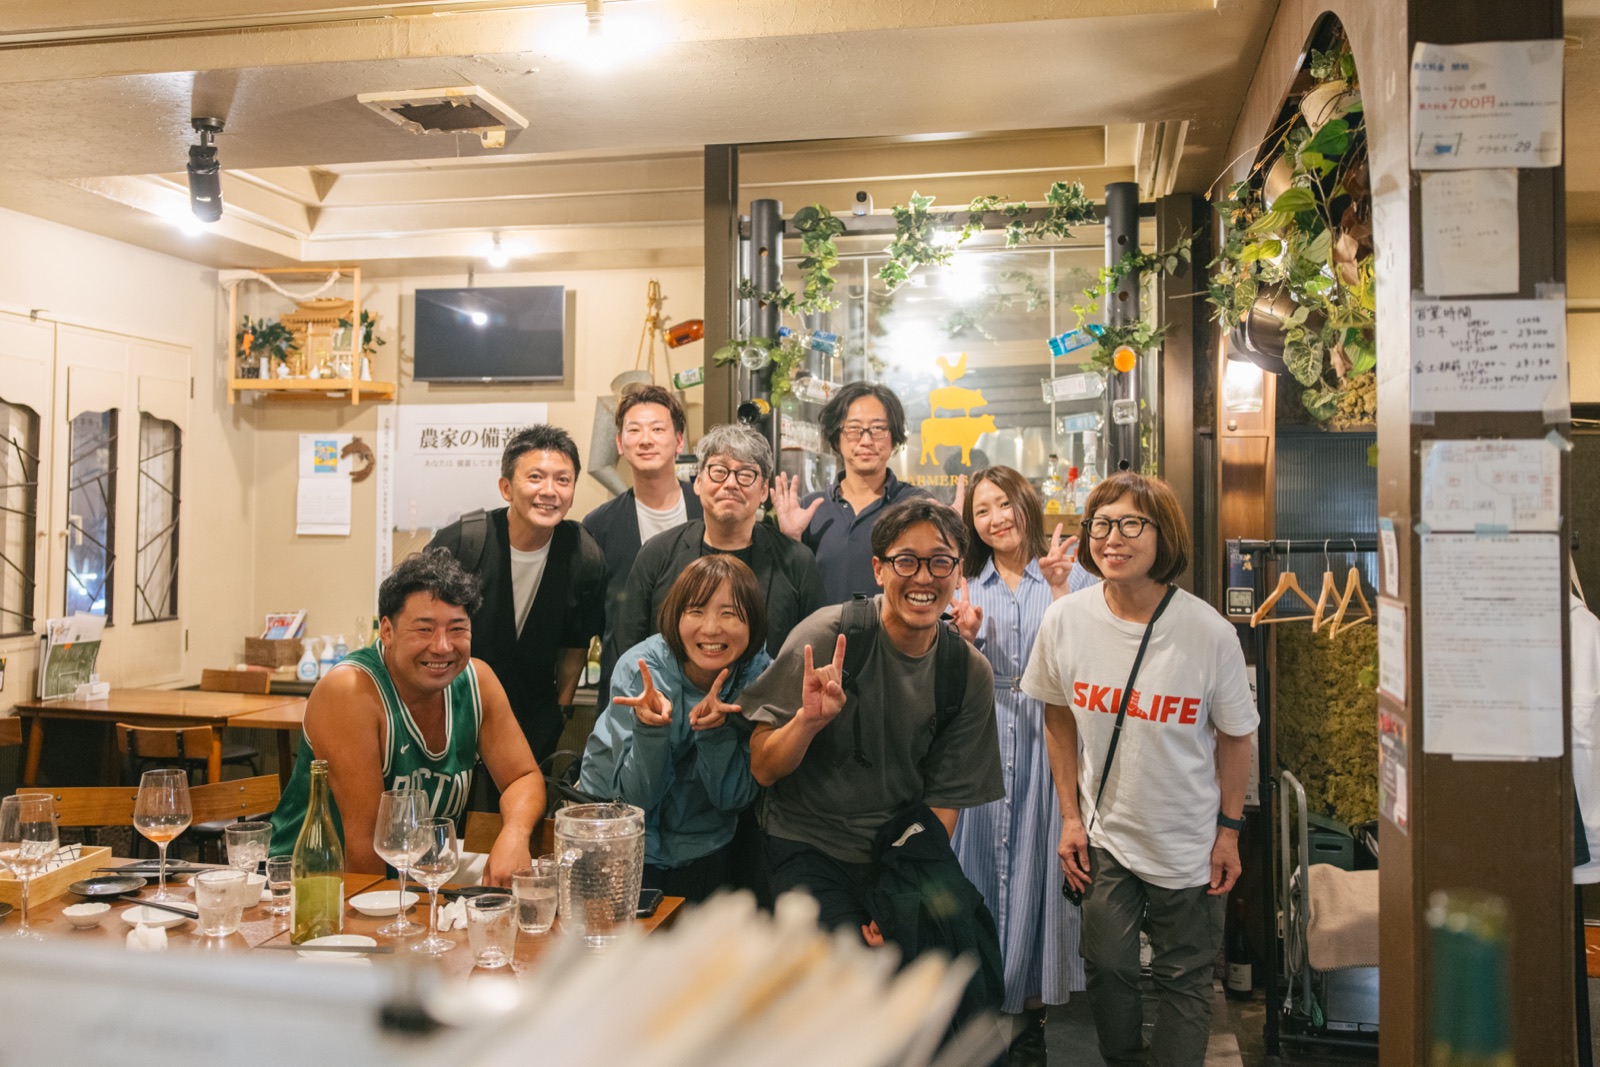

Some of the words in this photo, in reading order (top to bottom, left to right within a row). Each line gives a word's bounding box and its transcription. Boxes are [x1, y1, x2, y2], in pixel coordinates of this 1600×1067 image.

[1415, 305, 1472, 321] 営業時間
[897, 475, 969, 487] ARMERS
[1073, 681, 1123, 714] SKI
